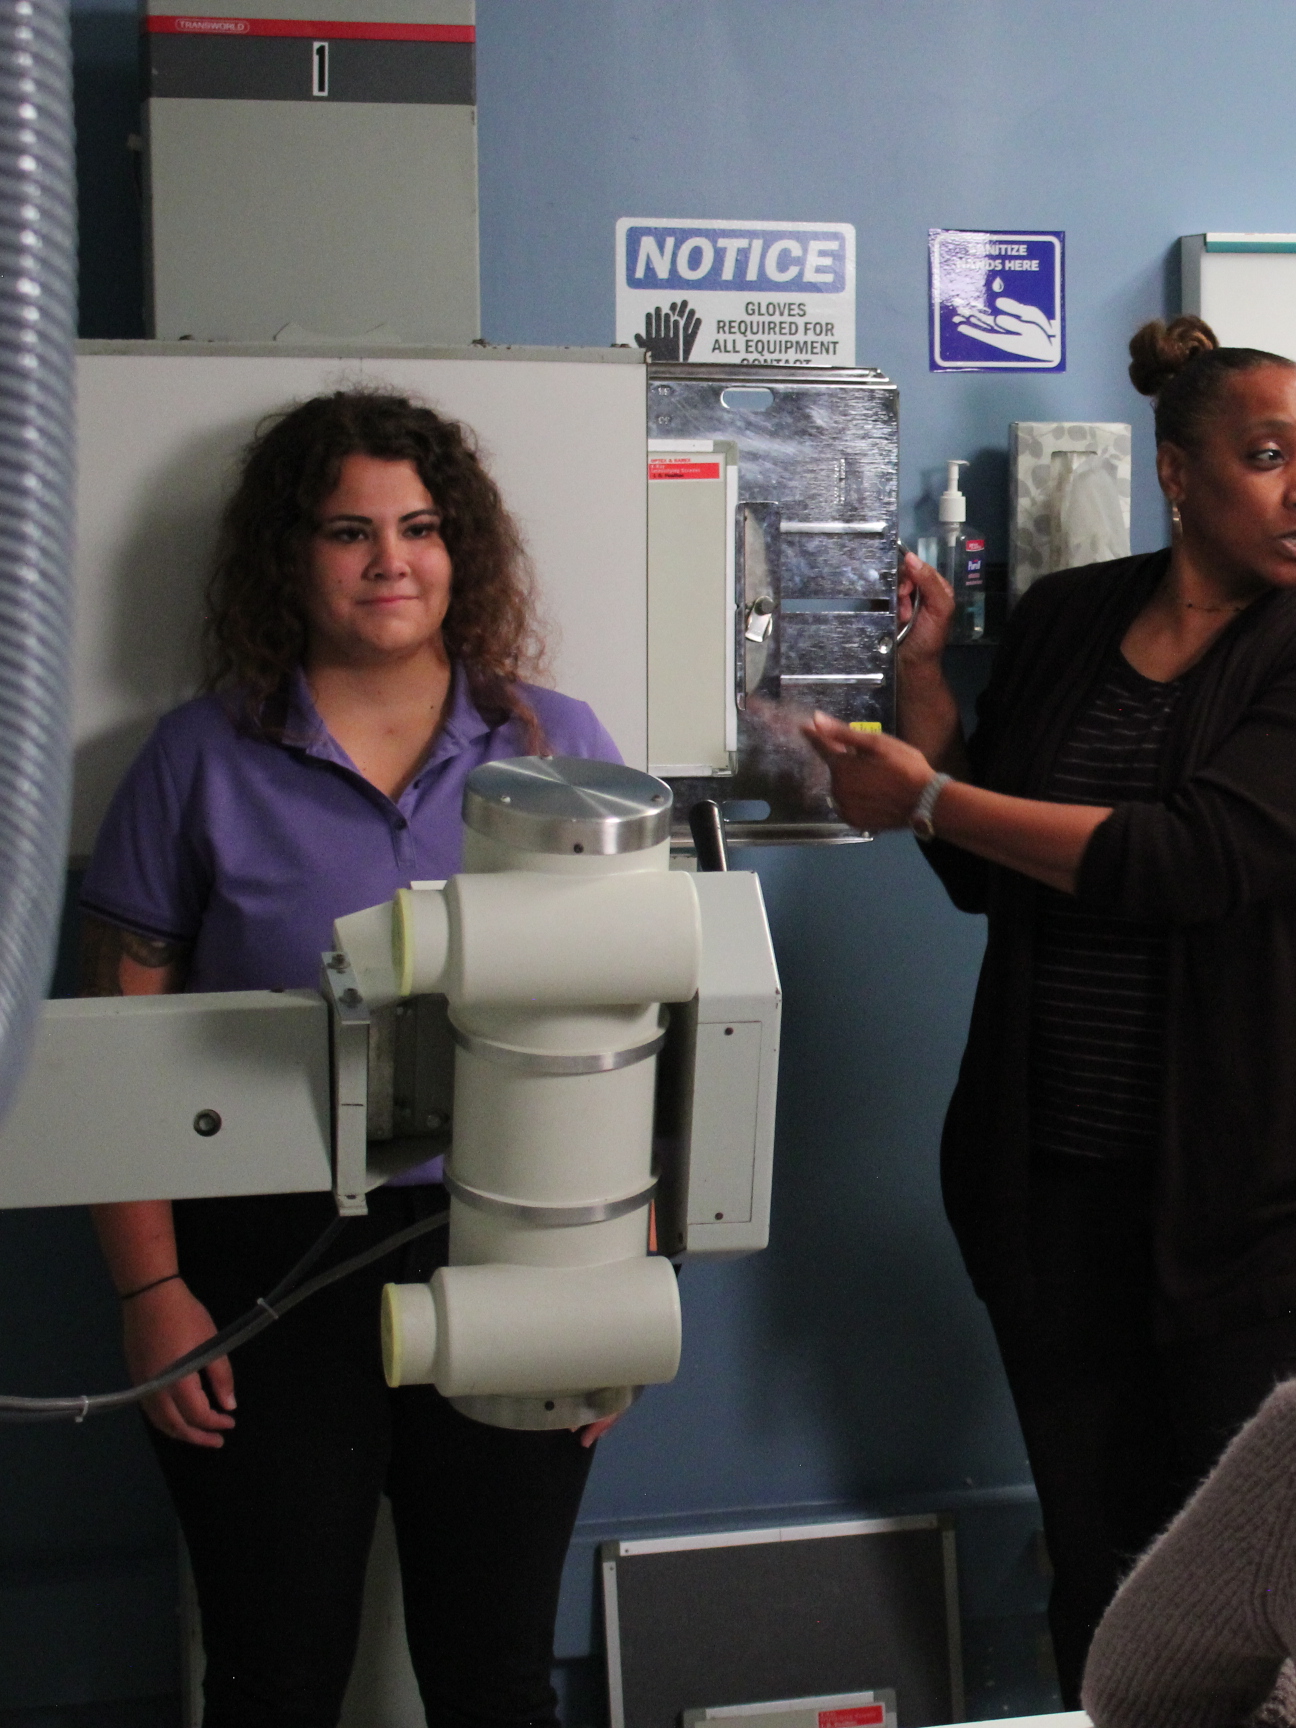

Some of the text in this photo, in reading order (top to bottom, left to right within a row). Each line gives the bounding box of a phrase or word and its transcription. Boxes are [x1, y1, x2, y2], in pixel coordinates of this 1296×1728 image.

[180, 20, 245, 31] TRANSWORLD
[315, 44, 326, 93] 1
[634, 235, 840, 283] NOTICE
[1004, 259, 1039, 272] HERE
[745, 301, 807, 318] GLOVES
[716, 320, 835, 338] REQUIRED FOR
[711, 338, 839, 357] ALL EQUIPMENT
